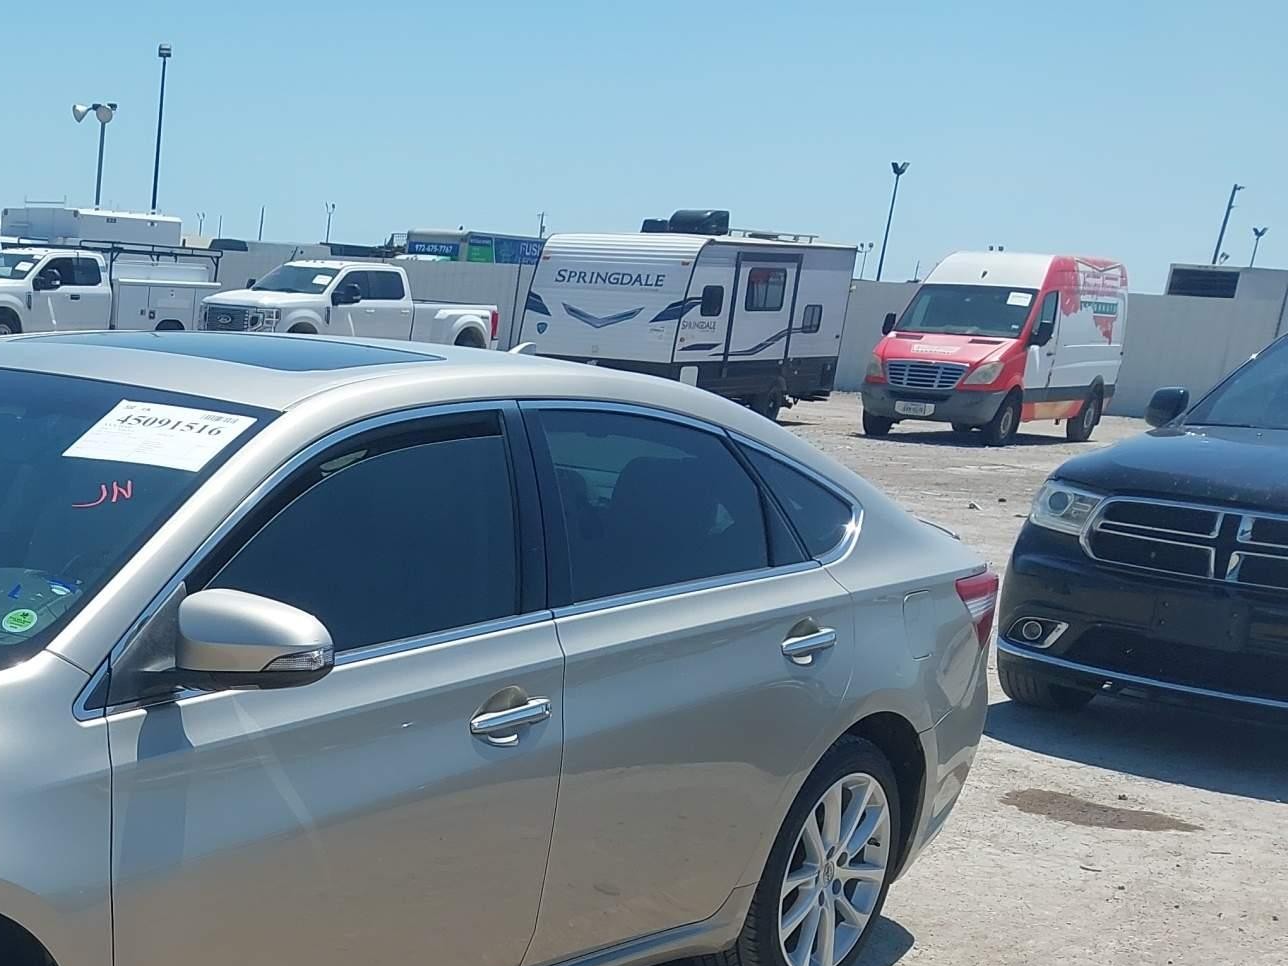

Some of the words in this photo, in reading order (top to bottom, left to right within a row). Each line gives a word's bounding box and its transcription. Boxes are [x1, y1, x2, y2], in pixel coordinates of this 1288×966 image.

[555, 269, 666, 288] SPRINGDALE
[681, 320, 716, 330] SPRINGDALE
[116, 413, 225, 437] 45091516
